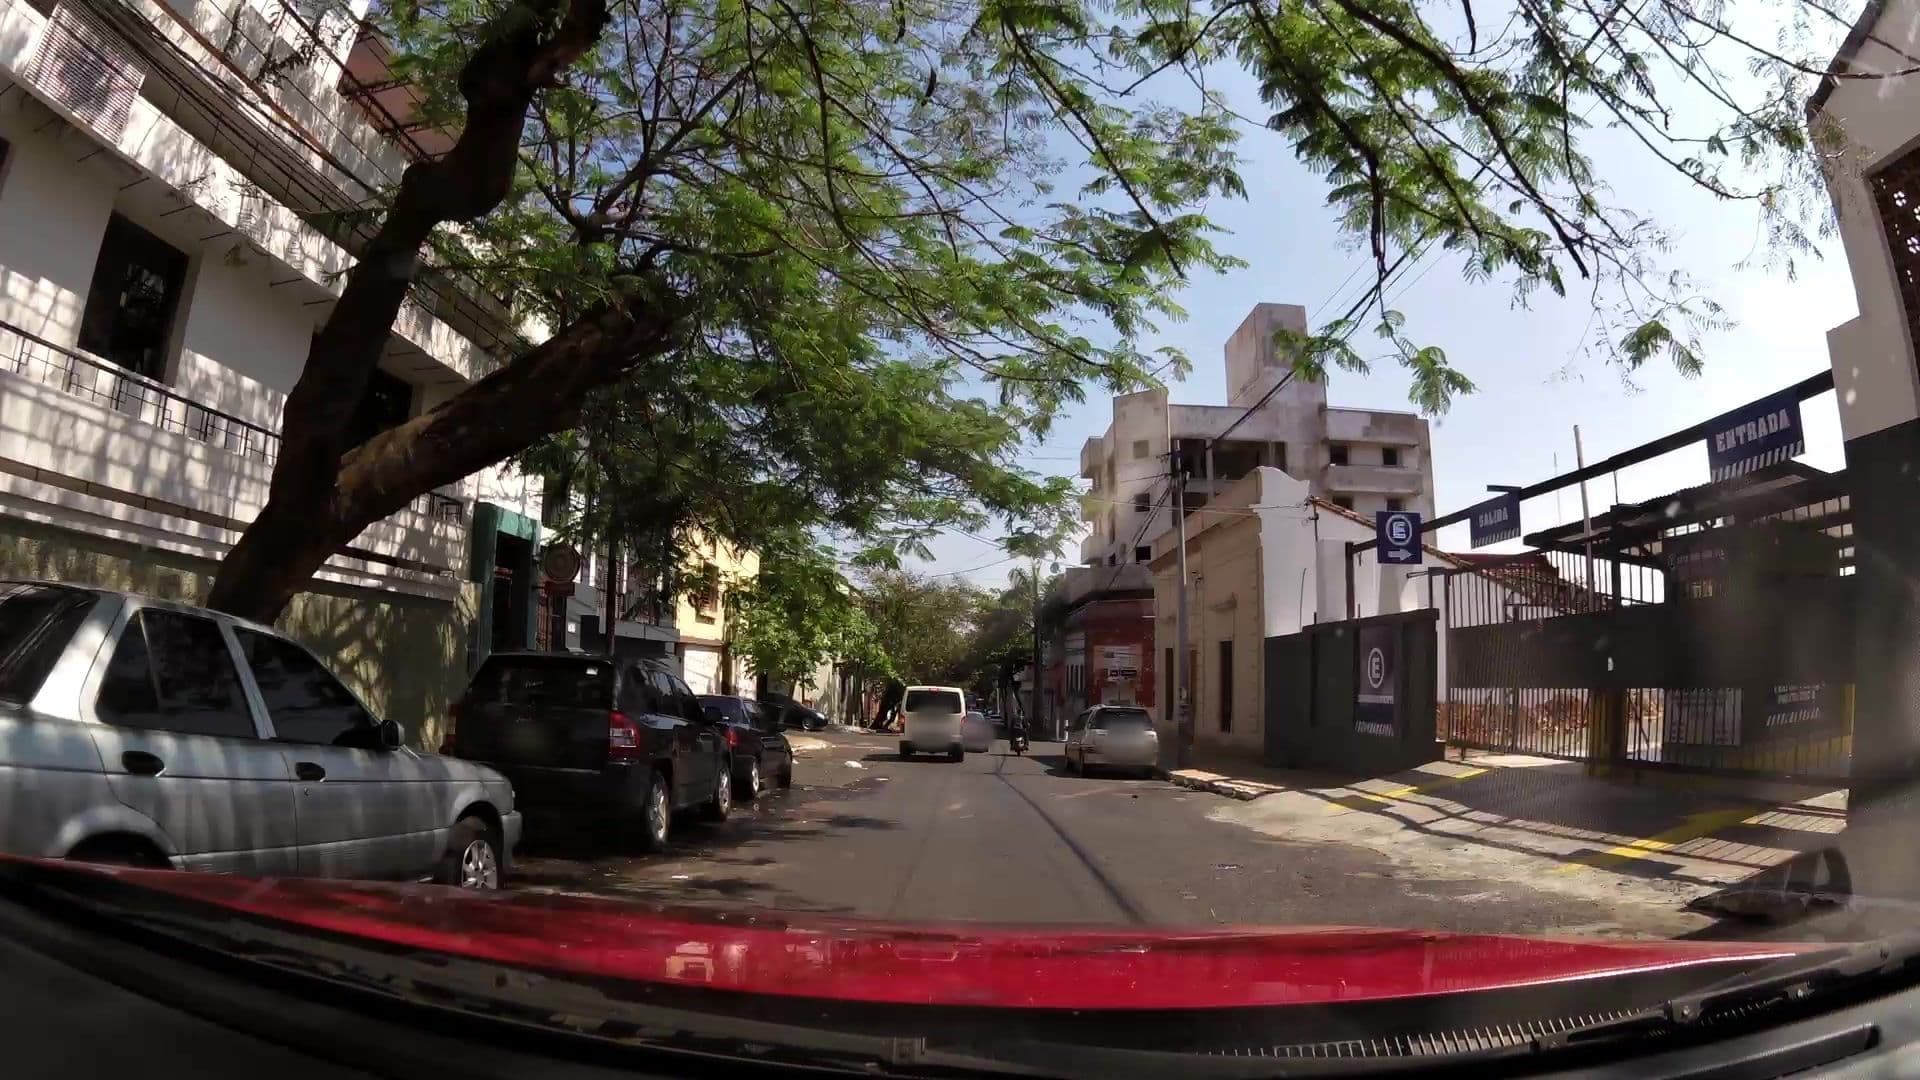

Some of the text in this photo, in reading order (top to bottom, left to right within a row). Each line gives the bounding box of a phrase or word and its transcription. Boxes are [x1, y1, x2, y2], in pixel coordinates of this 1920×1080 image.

[1715, 408, 1791, 453] ENTRADA
[1479, 507, 1509, 528] SALIDA
[1392, 521, 1406, 539] E
